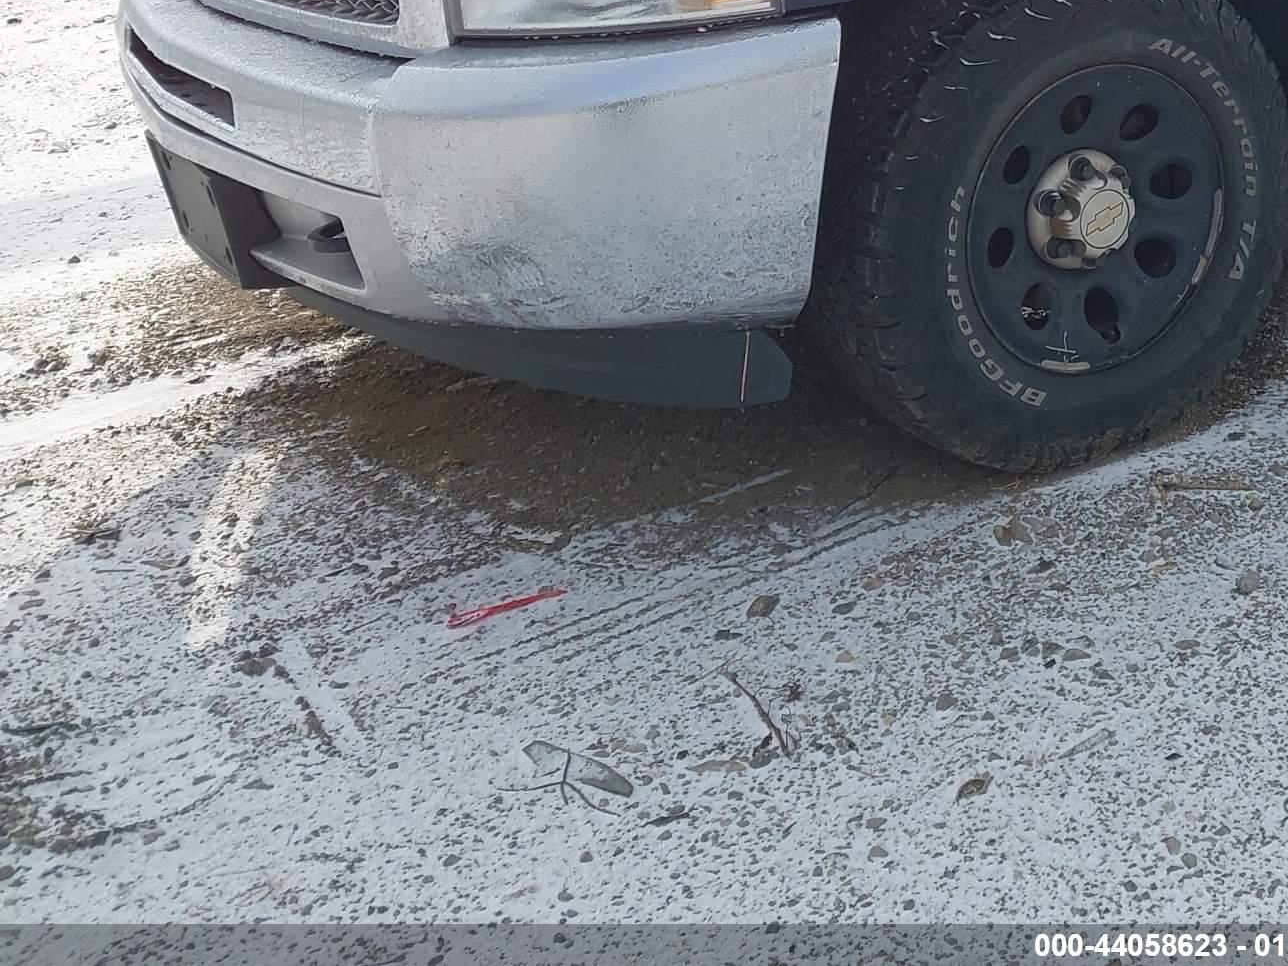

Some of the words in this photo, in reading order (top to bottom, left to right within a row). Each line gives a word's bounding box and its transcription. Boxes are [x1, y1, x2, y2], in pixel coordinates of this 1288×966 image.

[1149, 37, 1258, 196] All-Terrain
[1228, 220, 1256, 280] T/A
[945, 186, 1047, 407] BFGoodrich
